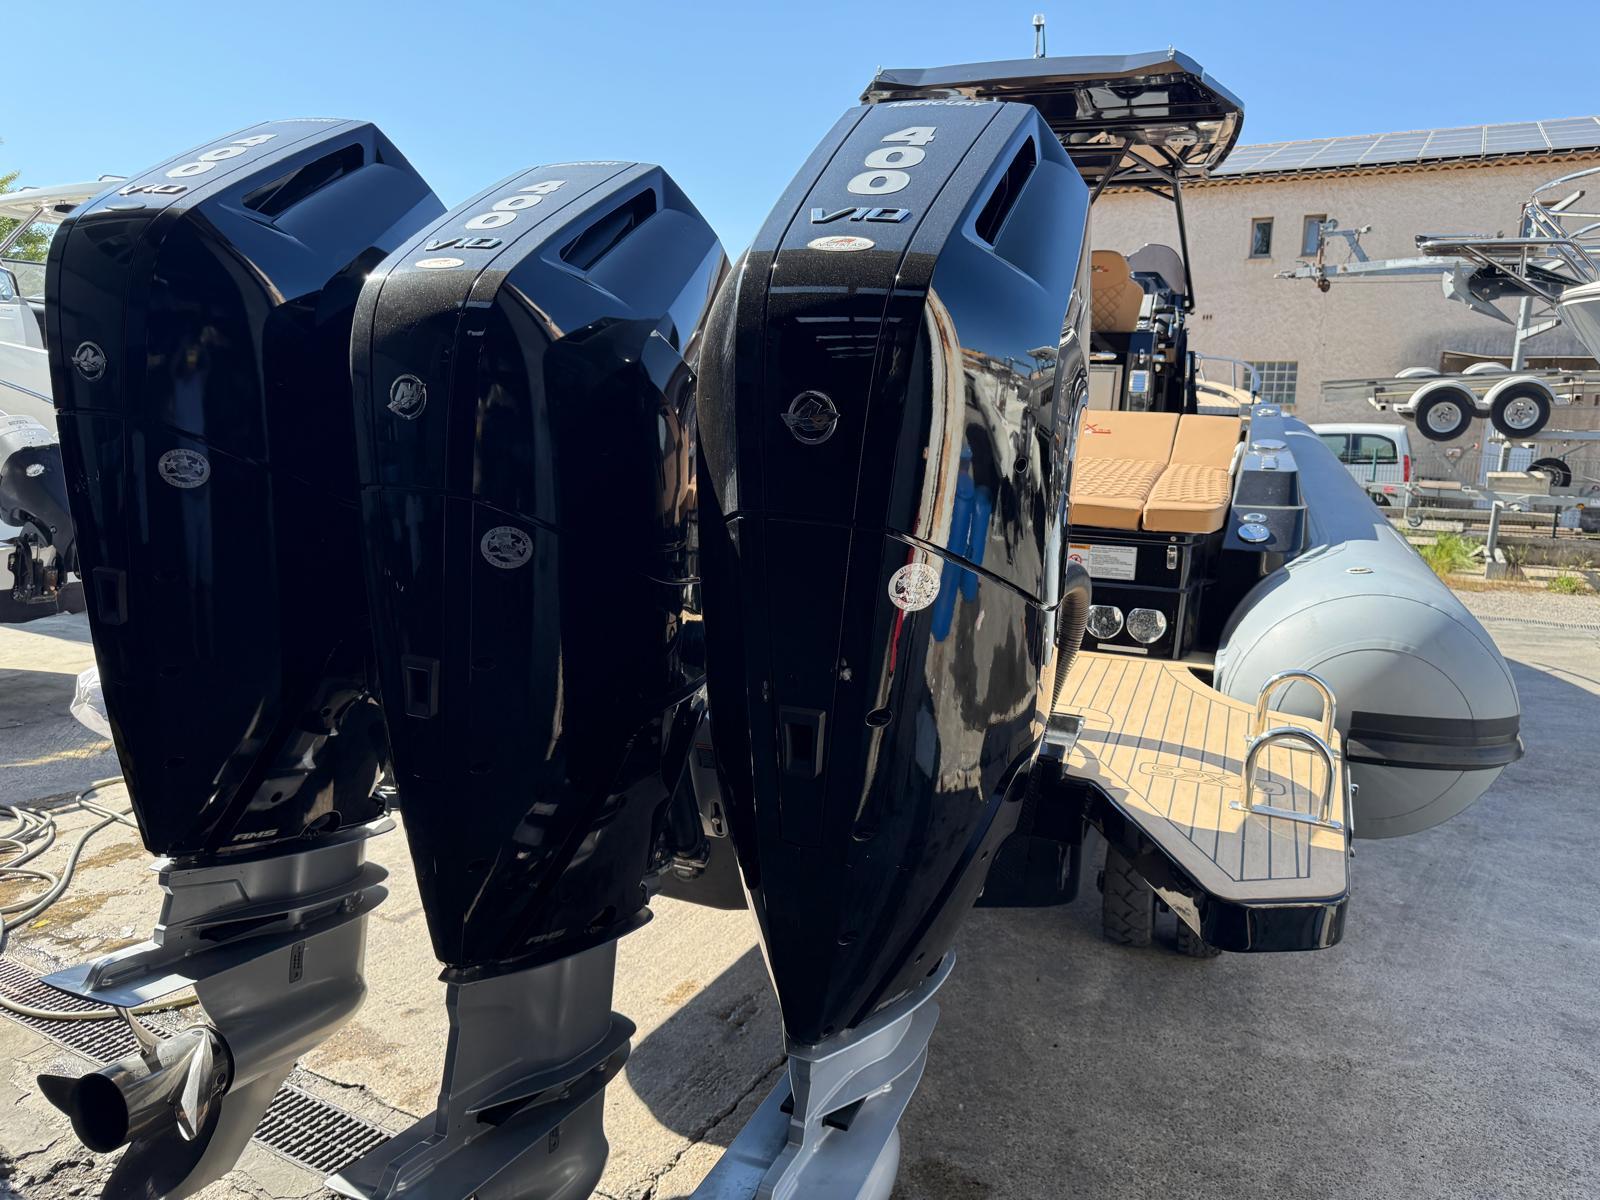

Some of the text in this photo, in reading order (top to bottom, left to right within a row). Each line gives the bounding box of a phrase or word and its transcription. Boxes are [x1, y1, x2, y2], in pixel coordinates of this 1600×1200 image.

[165, 134, 278, 178] 400
[847, 126, 938, 195] 400
[119, 183, 188, 196] V10
[464, 180, 567, 230] 400
[810, 207, 912, 224] V10
[425, 237, 503, 251] V10
